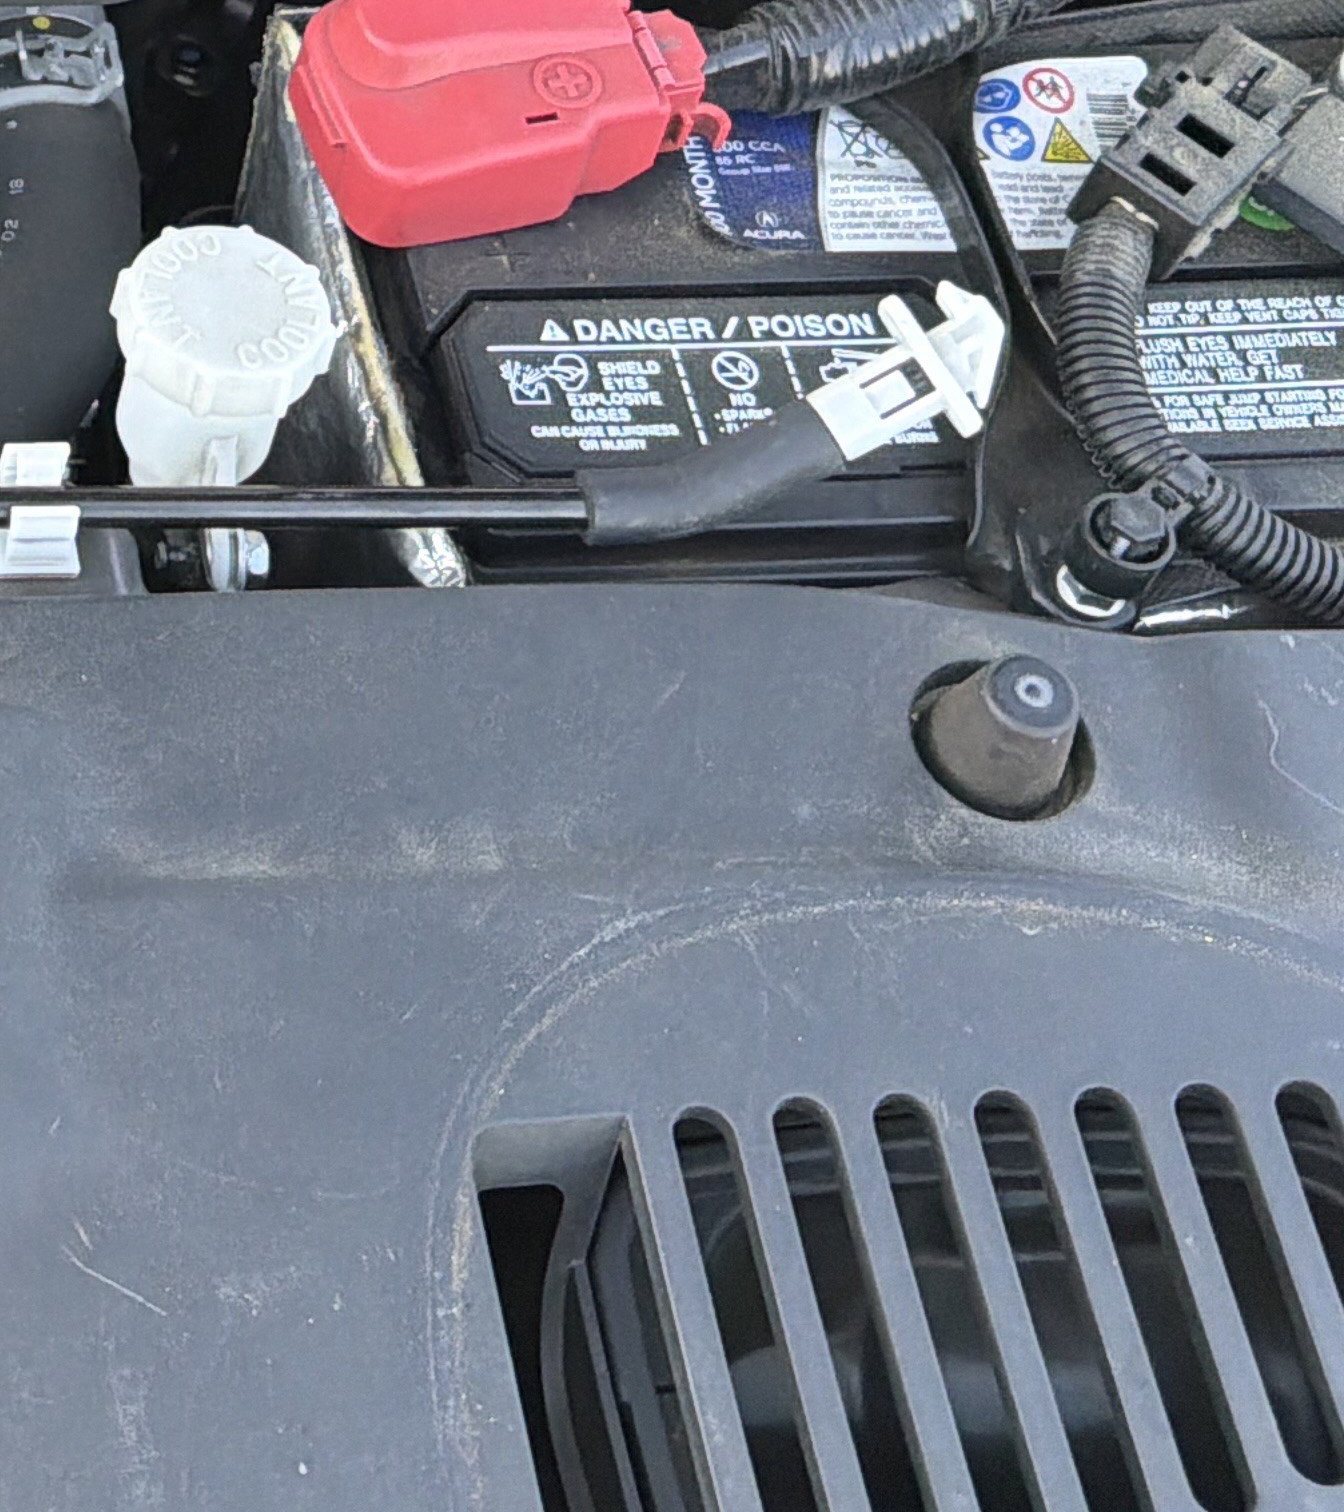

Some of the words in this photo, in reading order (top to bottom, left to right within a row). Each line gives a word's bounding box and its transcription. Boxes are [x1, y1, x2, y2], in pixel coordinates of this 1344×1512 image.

[747, 140, 787, 153] CCA
[684, 136, 721, 208] MONTH
[742, 228, 807, 240] ACURA
[1147, 301, 1182, 314] KEEP
[1184, 300, 1213, 313] OUT
[1215, 299, 1234, 312] OF
[1237, 298, 1266, 311] THE
[1267, 296, 1312, 309] REACH
[1314, 295, 1332, 308] OF
[1207, 312, 1242, 324] KEEP
[1245, 310, 1279, 323] VENT
[1283, 309, 1319, 321] CAPS
[573, 317, 713, 343] DANGER
[747, 314, 875, 339] POISON
[1186, 335, 1230, 352] EYES
[1232, 331, 1338, 349] IMMEDIATELY
[1139, 354, 1181, 369] WITH
[1246, 349, 1279, 364] GET
[596, 360, 661, 376] SHIELD
[1143, 369, 1216, 385] MEDICAL
[1217, 366, 1259, 383] HELP
[1262, 364, 1305, 380] FAST
[601, 376, 649, 391] EYES
[566, 392, 664, 407] EXPLOSIVE
[728, 393, 757, 407] NO
[570, 408, 632, 423] GASES
